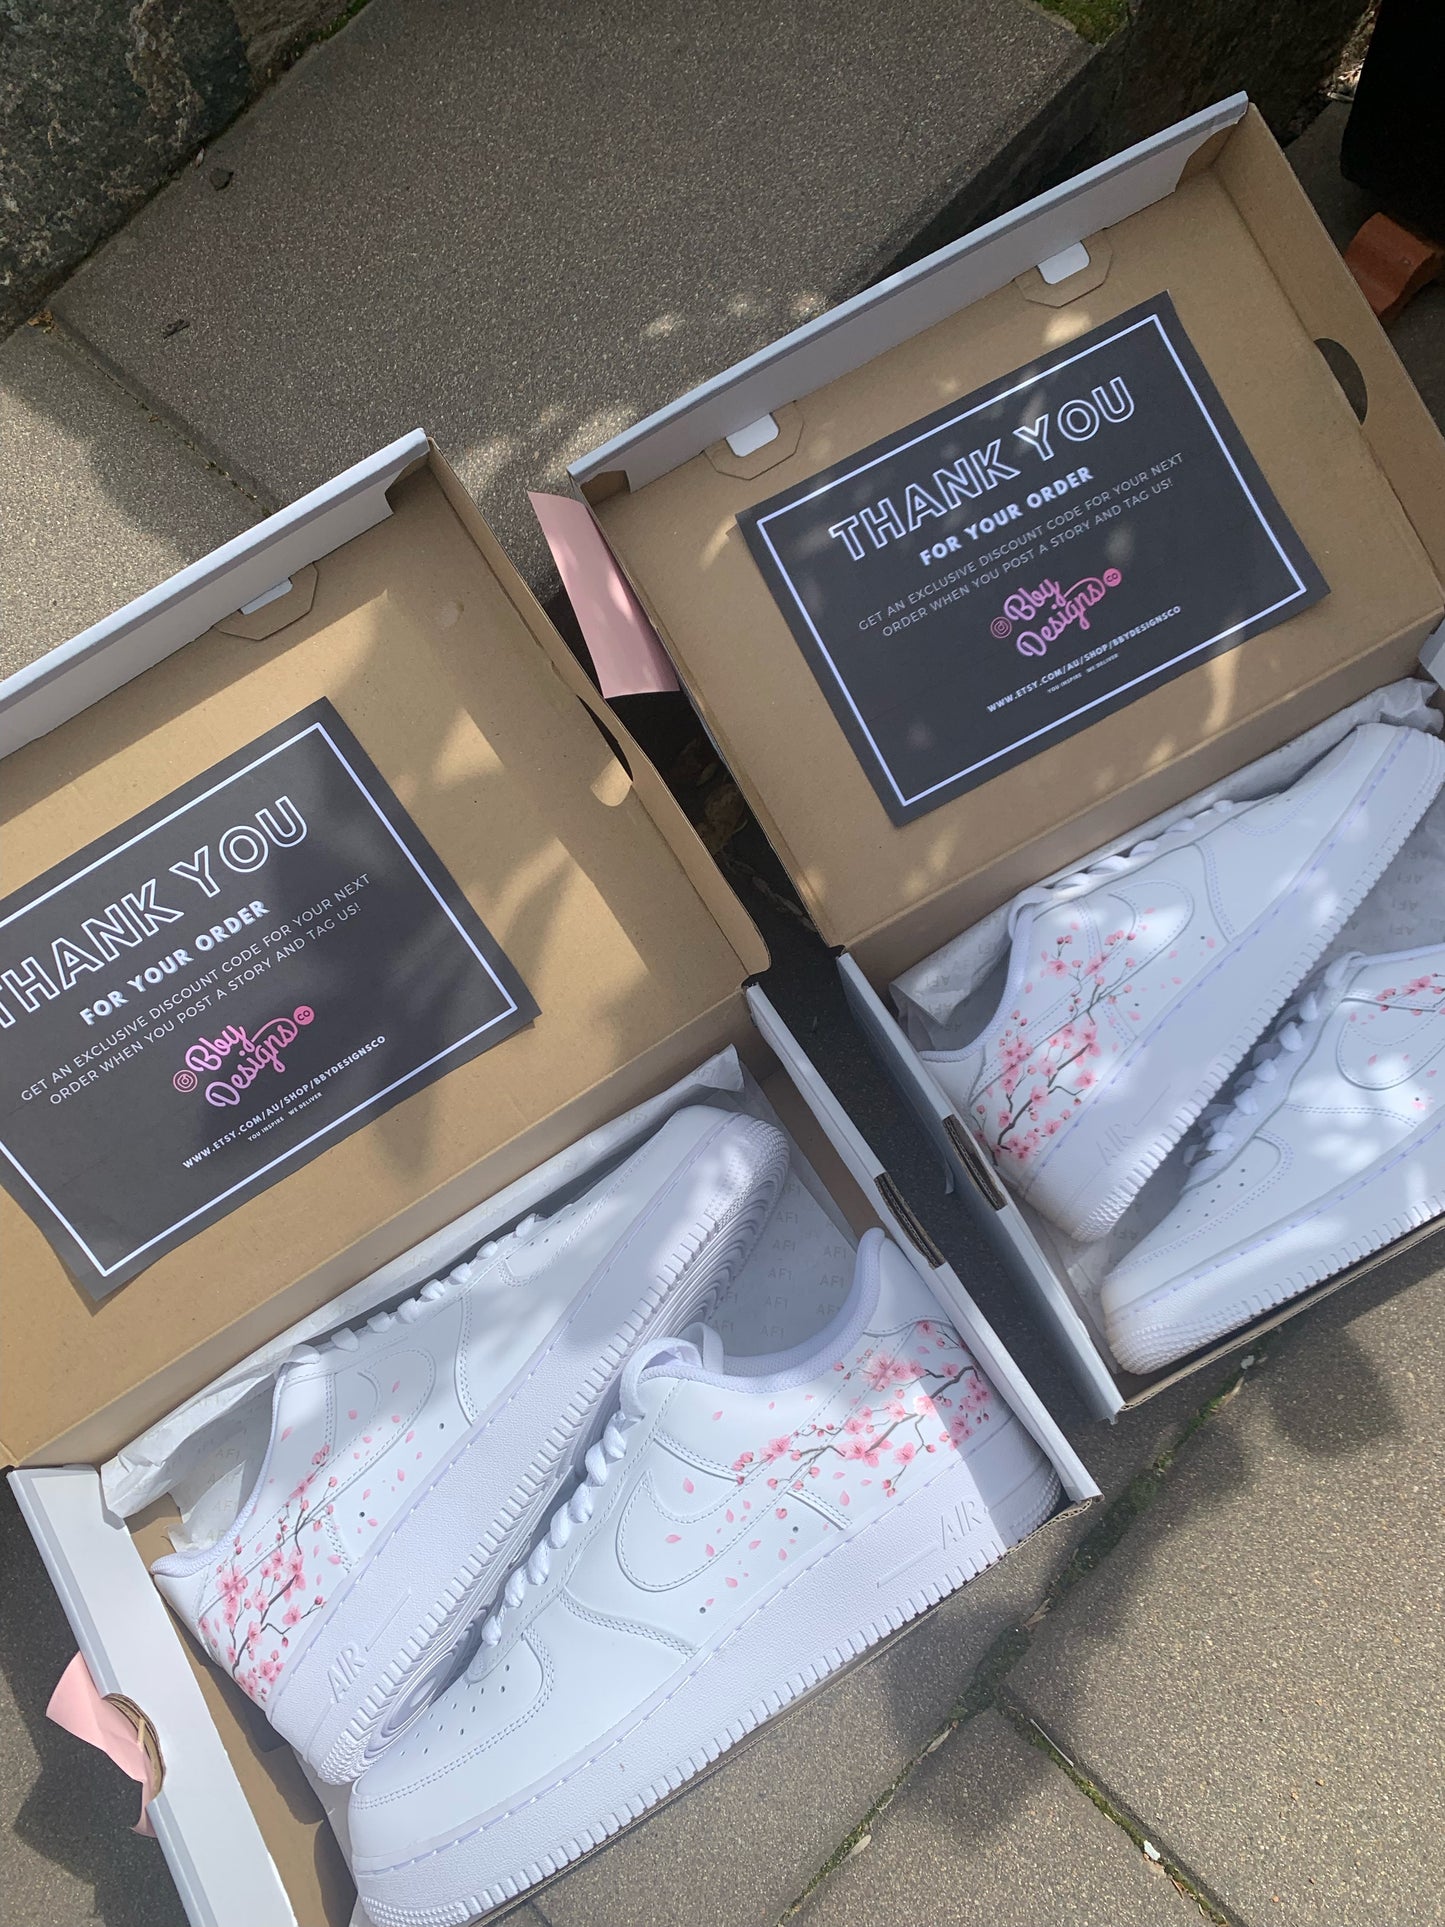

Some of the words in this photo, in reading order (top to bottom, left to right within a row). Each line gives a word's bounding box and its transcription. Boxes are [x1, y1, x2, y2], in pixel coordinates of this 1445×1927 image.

[828, 439, 1021, 561] THANK
[1013, 376, 1135, 461] YOU
[919, 535, 962, 566] FOR
[964, 504, 1023, 540] YOUR
[1026, 466, 1094, 508] ORDER
[859, 611, 883, 630] GET
[887, 600, 906, 616] AN
[908, 562, 976, 604] EXCLUSIVE
[979, 525, 1043, 566] DISCOUNT
[1047, 505, 1083, 530] CODE
[1085, 491, 1111, 510] FOR
[1113, 472, 1149, 495] YOUR
[1151, 452, 1184, 476] NEXT
[882, 607, 928, 636] ORDER
[929, 585, 970, 611] WHEN
[971, 569, 1000, 588] YOU
[1002, 550, 1035, 573] POST
[1039, 544, 1048, 554] A
[1050, 520, 1090, 548] STORY
[1095, 505, 1122, 525] AND
[1123, 490, 1149, 509] TAG
[1151, 477, 1173, 494] US!
[987, 605, 1181, 713] WWW.ETSY.COM/AU/SHOP/BBYDESIGNSCO
[1016, 577, 1106, 657] Designs
[0, 878, 184, 1028] HANK
[169, 795, 307, 898] YOU
[79, 990, 129, 1025] FOR
[127, 948, 194, 993] YOUR
[195, 900, 270, 951] ORDER
[21, 1079, 48, 1101] GET
[51, 1064, 72, 1084] AN
[73, 1016, 148, 1068] EXCLUSIVE
[149, 969, 219, 1020] DISCOUNT
[221, 943, 262, 973] CODE
[262, 924, 292, 947] FOR
[292, 898, 333, 927] YOUR
[334, 873, 371, 902] NEXT
[50, 1069, 100, 1105] ORDER
[99, 1041, 144, 1073] WHEN
[144, 1020, 175, 1044] YOU
[176, 995, 213, 1024] POST
[216, 988, 228, 1000] A
[227, 957, 272, 991] STORY
[276, 937, 306, 962] AND
[306, 918, 336, 940] TAG
[336, 902, 362, 922] US!
[182, 1035, 386, 1169] WWW.ETSY.COM/AU/SHOP/BBYDESIGNSCO
[205, 1017, 298, 1107] Designs
[248, 1131, 261, 1142] YOU
[261, 1116, 285, 1136] INSPIRE
[288, 1107, 299, 1116] WE
[298, 1091, 323, 1110] DELIVER
[941, 1500, 982, 1550] AIR
[327, 1644, 366, 1703] AIR
